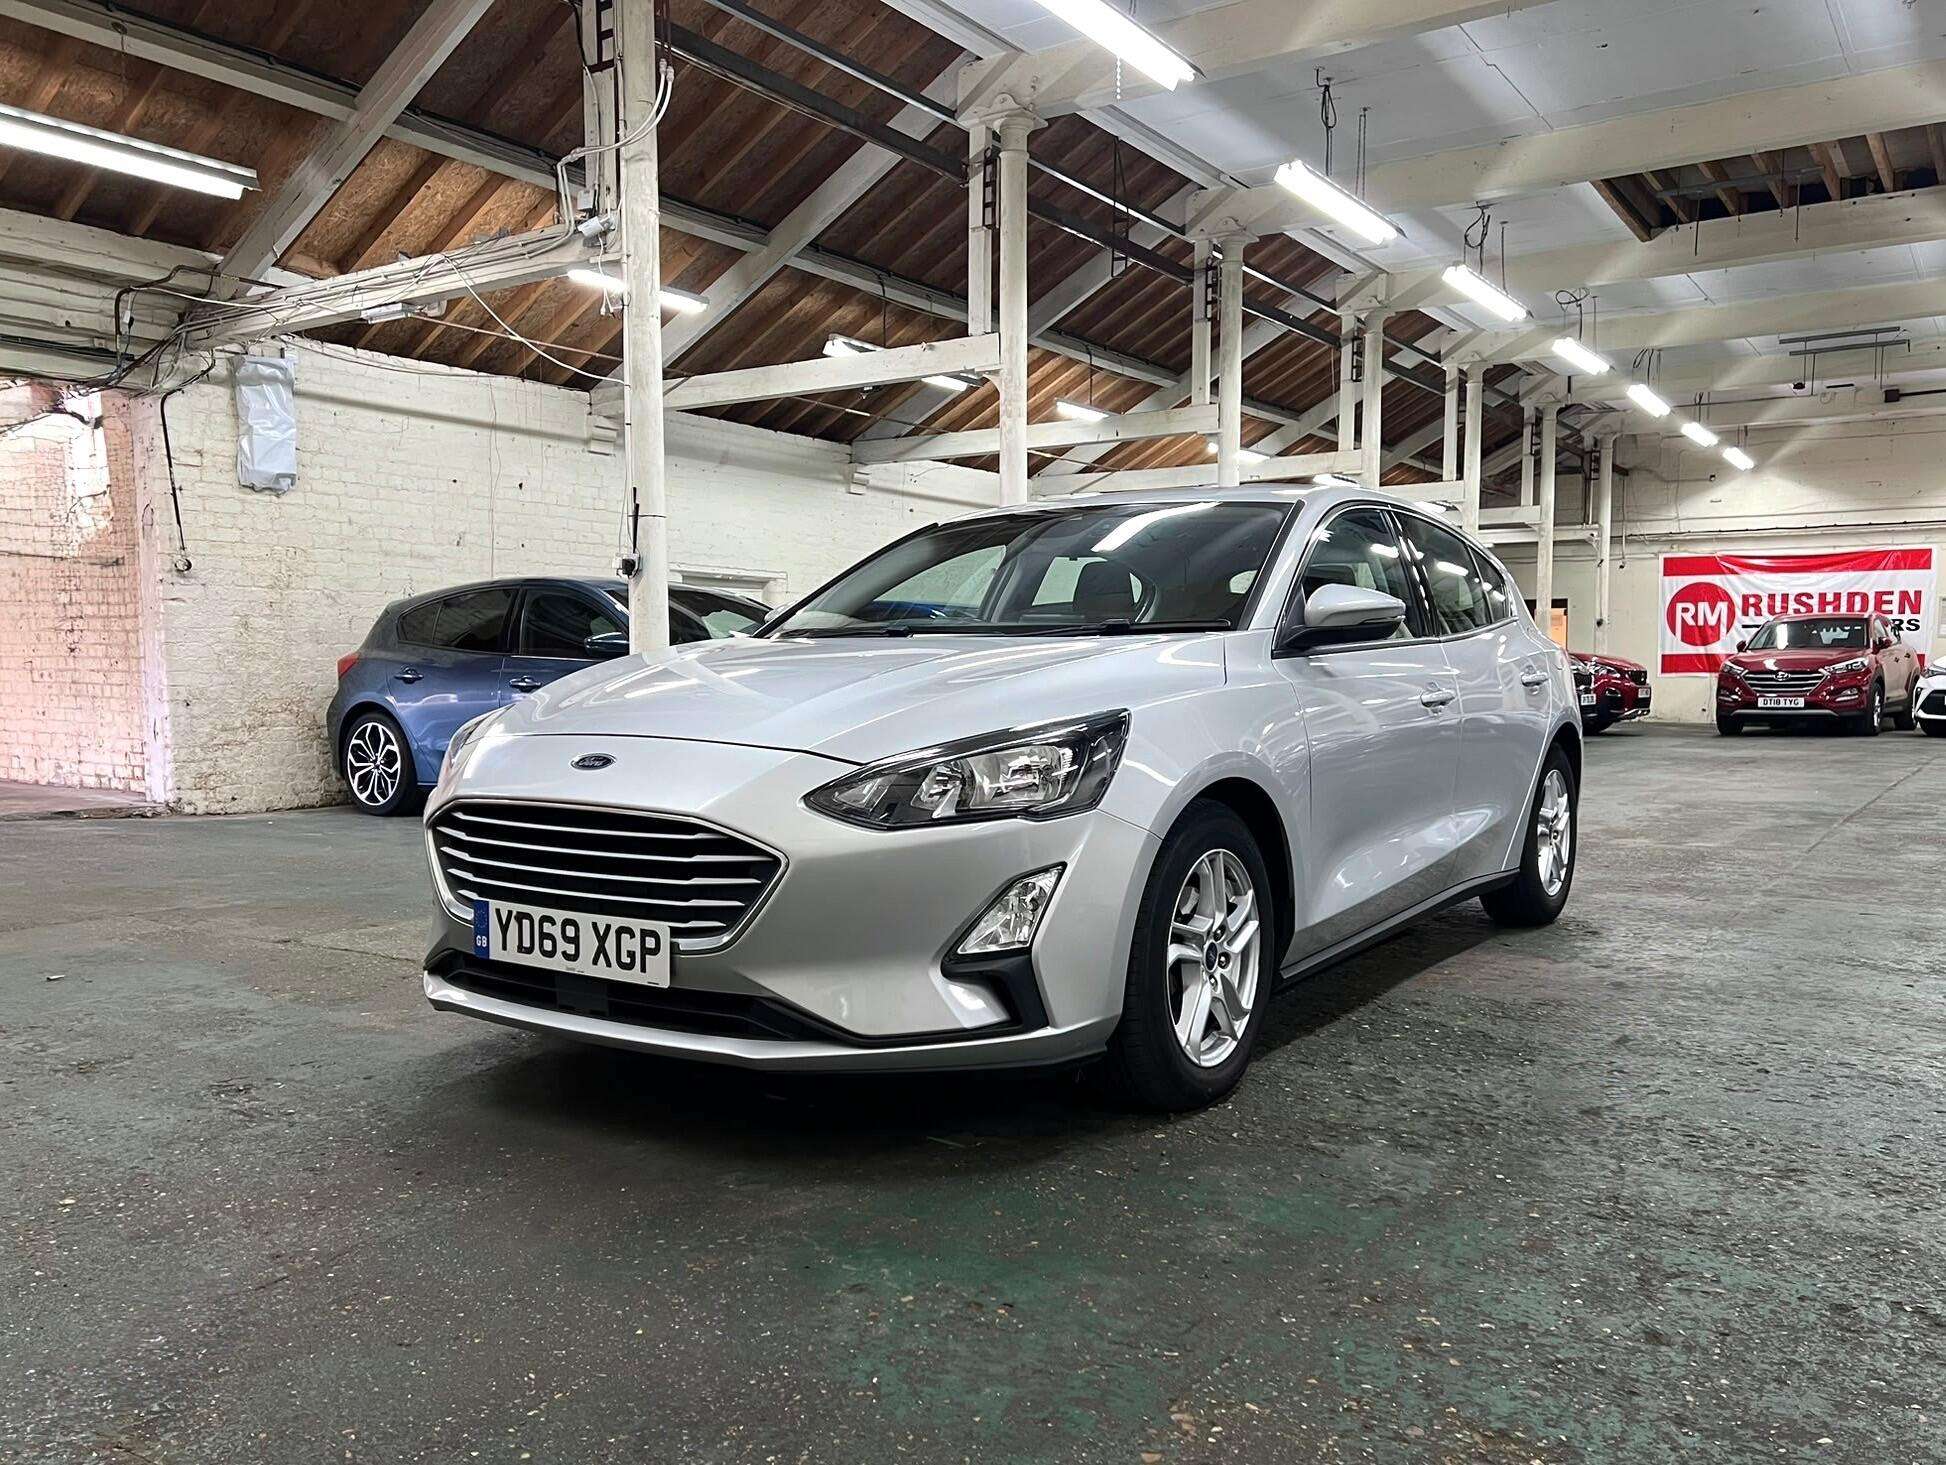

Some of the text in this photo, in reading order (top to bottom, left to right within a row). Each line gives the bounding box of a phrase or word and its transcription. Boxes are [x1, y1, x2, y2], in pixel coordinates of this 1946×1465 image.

[1741, 590, 1922, 616] RUSHDEN
[1675, 601, 1728, 646] RM
[1783, 698, 1799, 706] TYG
[476, 935, 487, 947] GB
[495, 908, 662, 974] YD69 XGP
